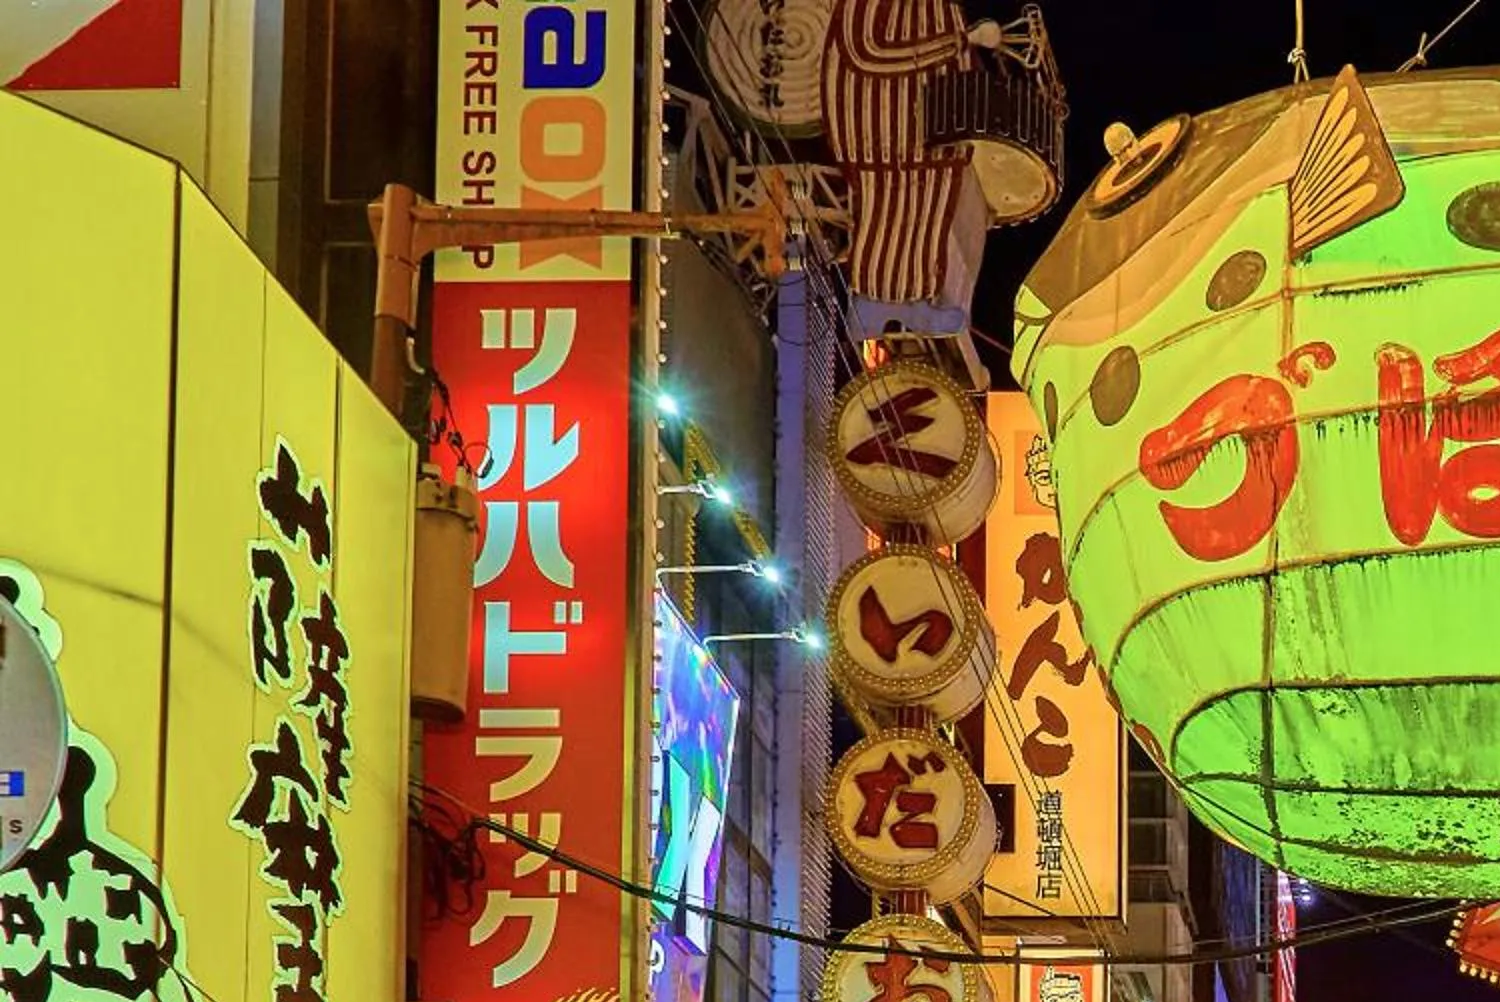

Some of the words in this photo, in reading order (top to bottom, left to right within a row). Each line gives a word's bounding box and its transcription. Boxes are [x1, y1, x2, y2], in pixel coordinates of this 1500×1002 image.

[464, 25, 498, 135] FREE
[460, 150, 496, 270] SHP
[470, 307, 586, 990] ツルハドラッグ
[1036, 790, 1063, 900] 道頓堀店
